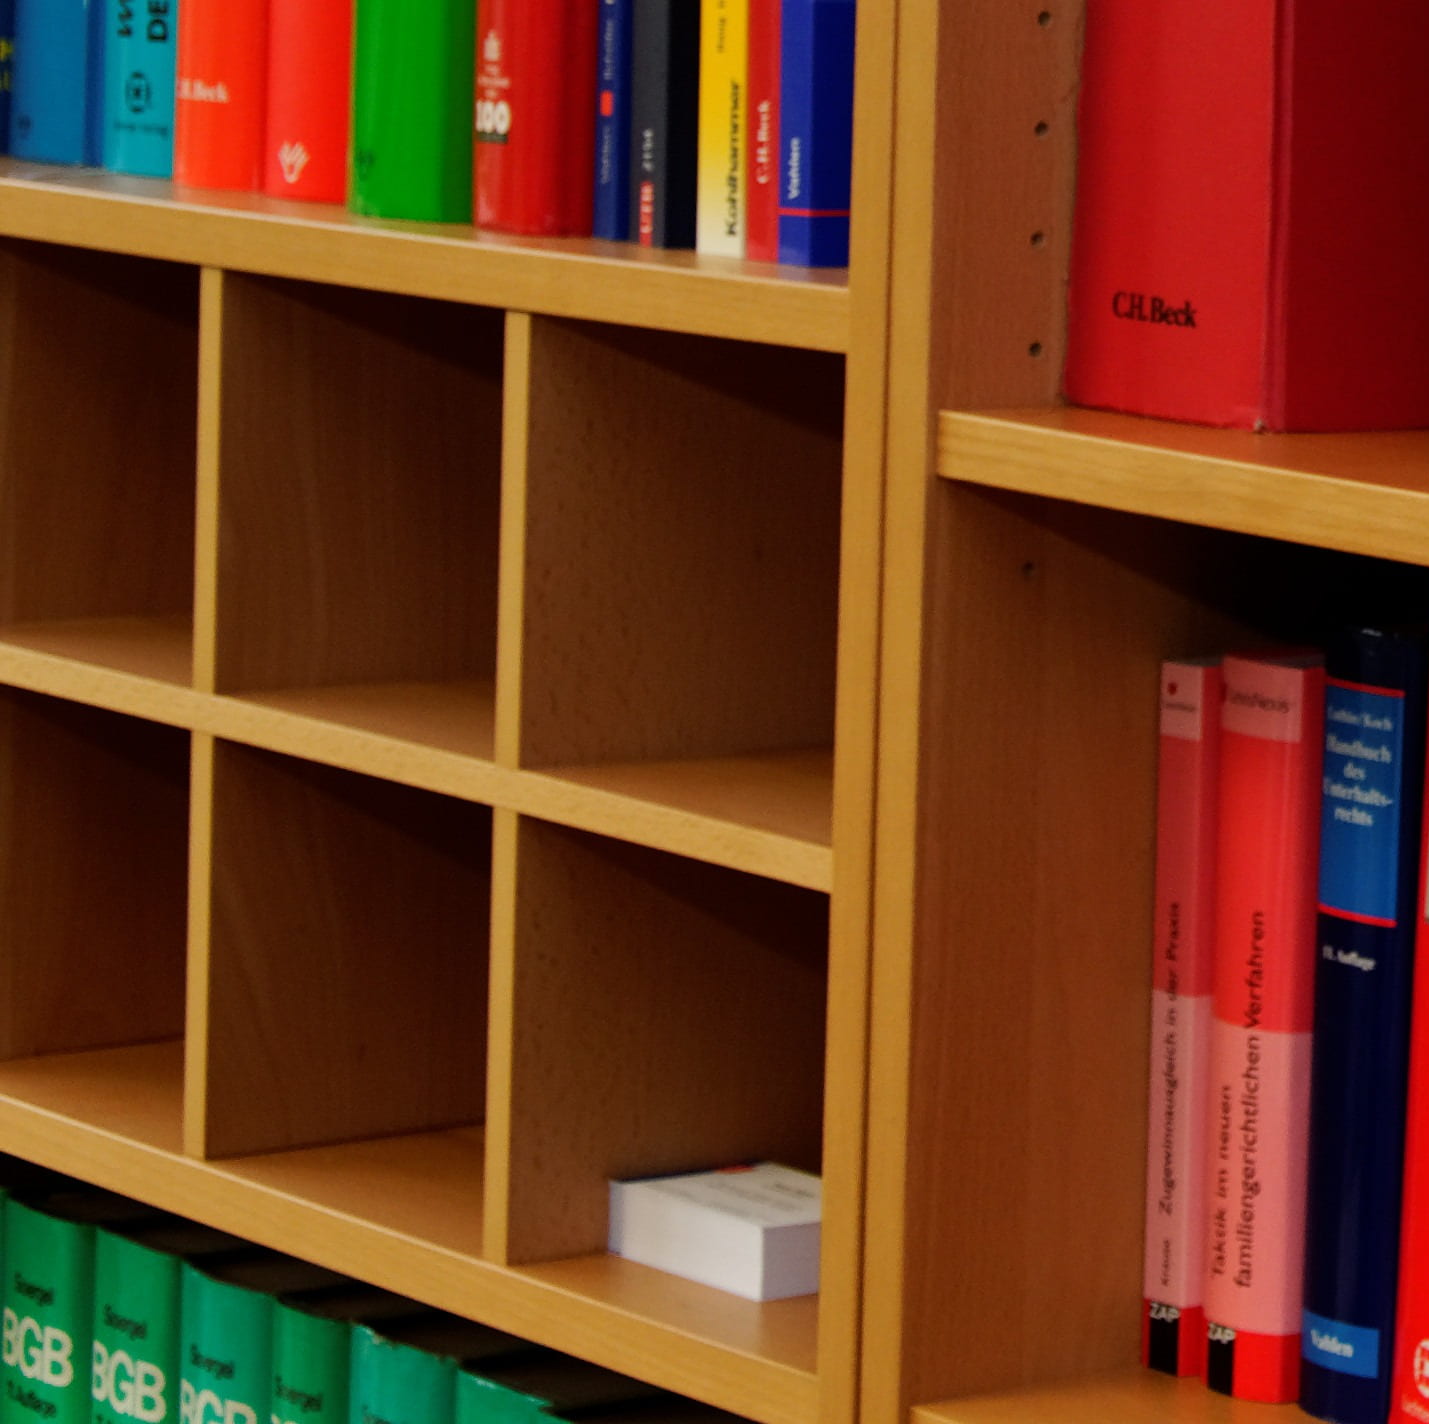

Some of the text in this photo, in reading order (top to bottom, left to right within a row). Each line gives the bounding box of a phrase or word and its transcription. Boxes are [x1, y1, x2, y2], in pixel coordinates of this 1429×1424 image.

[727, 82, 741, 237] Kohlhammer
[1235, 909, 1265, 1288] familiengerichtlichen Verfahren
[1, 1307, 74, 1388] BGB
[93, 1339, 166, 1423] BGB
